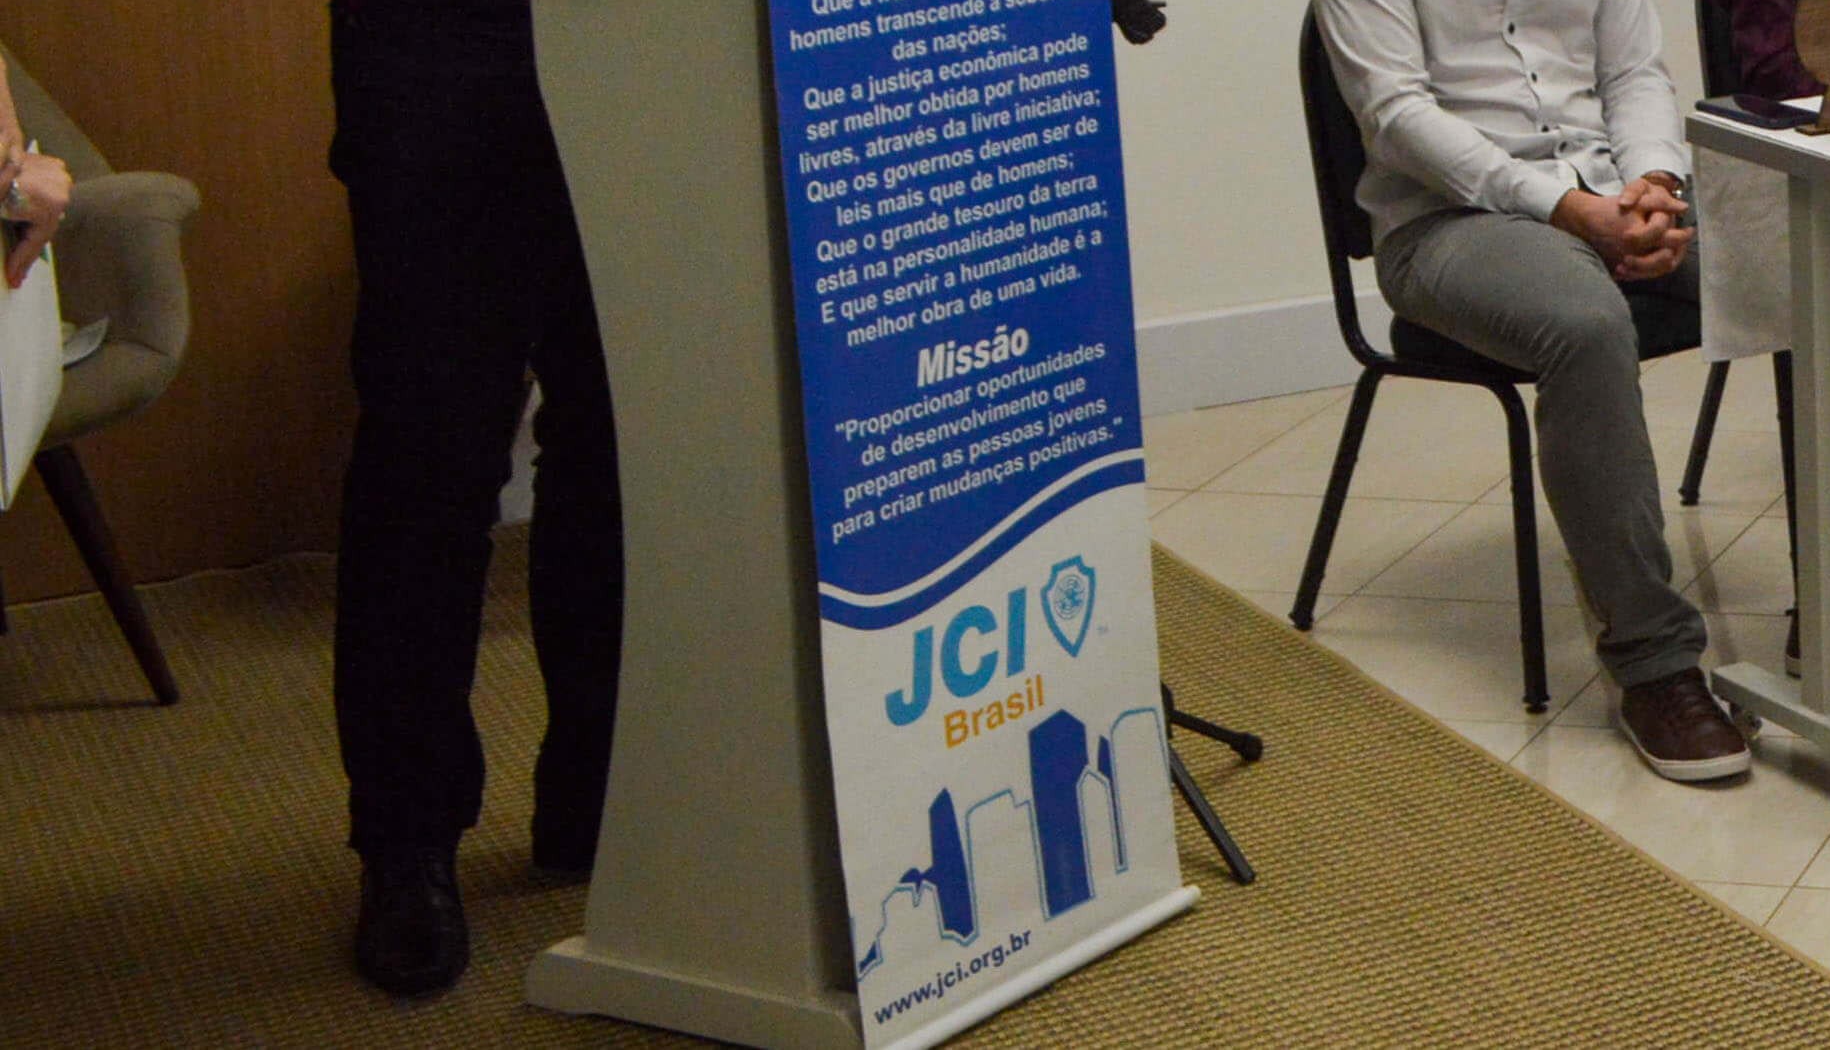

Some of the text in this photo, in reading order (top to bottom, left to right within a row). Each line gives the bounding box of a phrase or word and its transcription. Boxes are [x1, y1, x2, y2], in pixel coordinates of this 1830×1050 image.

[789, 20, 872, 50] homens
[803, 33, 1087, 109] Que a justiça econômica pode
[892, 23, 1006, 60] das nações;
[799, 89, 1100, 173] livres, através da livre iniciativa;
[806, 63, 1089, 140] ser melhor obtida por homens
[806, 115, 1098, 202] Que os governos devem ser de
[836, 153, 1073, 226] leis mais que de homens;
[816, 175, 1097, 262] Que o grande tesouro da terra
[816, 201, 1107, 294] está na personalidade humana;
[820, 229, 1102, 323] E que servir a humanidade é a
[847, 263, 1081, 346] melhor obra de uma vida.
[916, 324, 1029, 387] Missão
[976, 342, 1105, 398] oportunidades
[843, 398, 1107, 508] preparem as pessoas jovens
[861, 377, 1085, 466] de desenvolvimento que
[831, 509, 875, 544] para
[879, 491, 924, 520] criar
[928, 456, 1024, 503] mudanças
[885, 587, 1027, 727] JCI
[944, 675, 1045, 749] Brasil
[874, 929, 1032, 1025] www.jci.org.br
